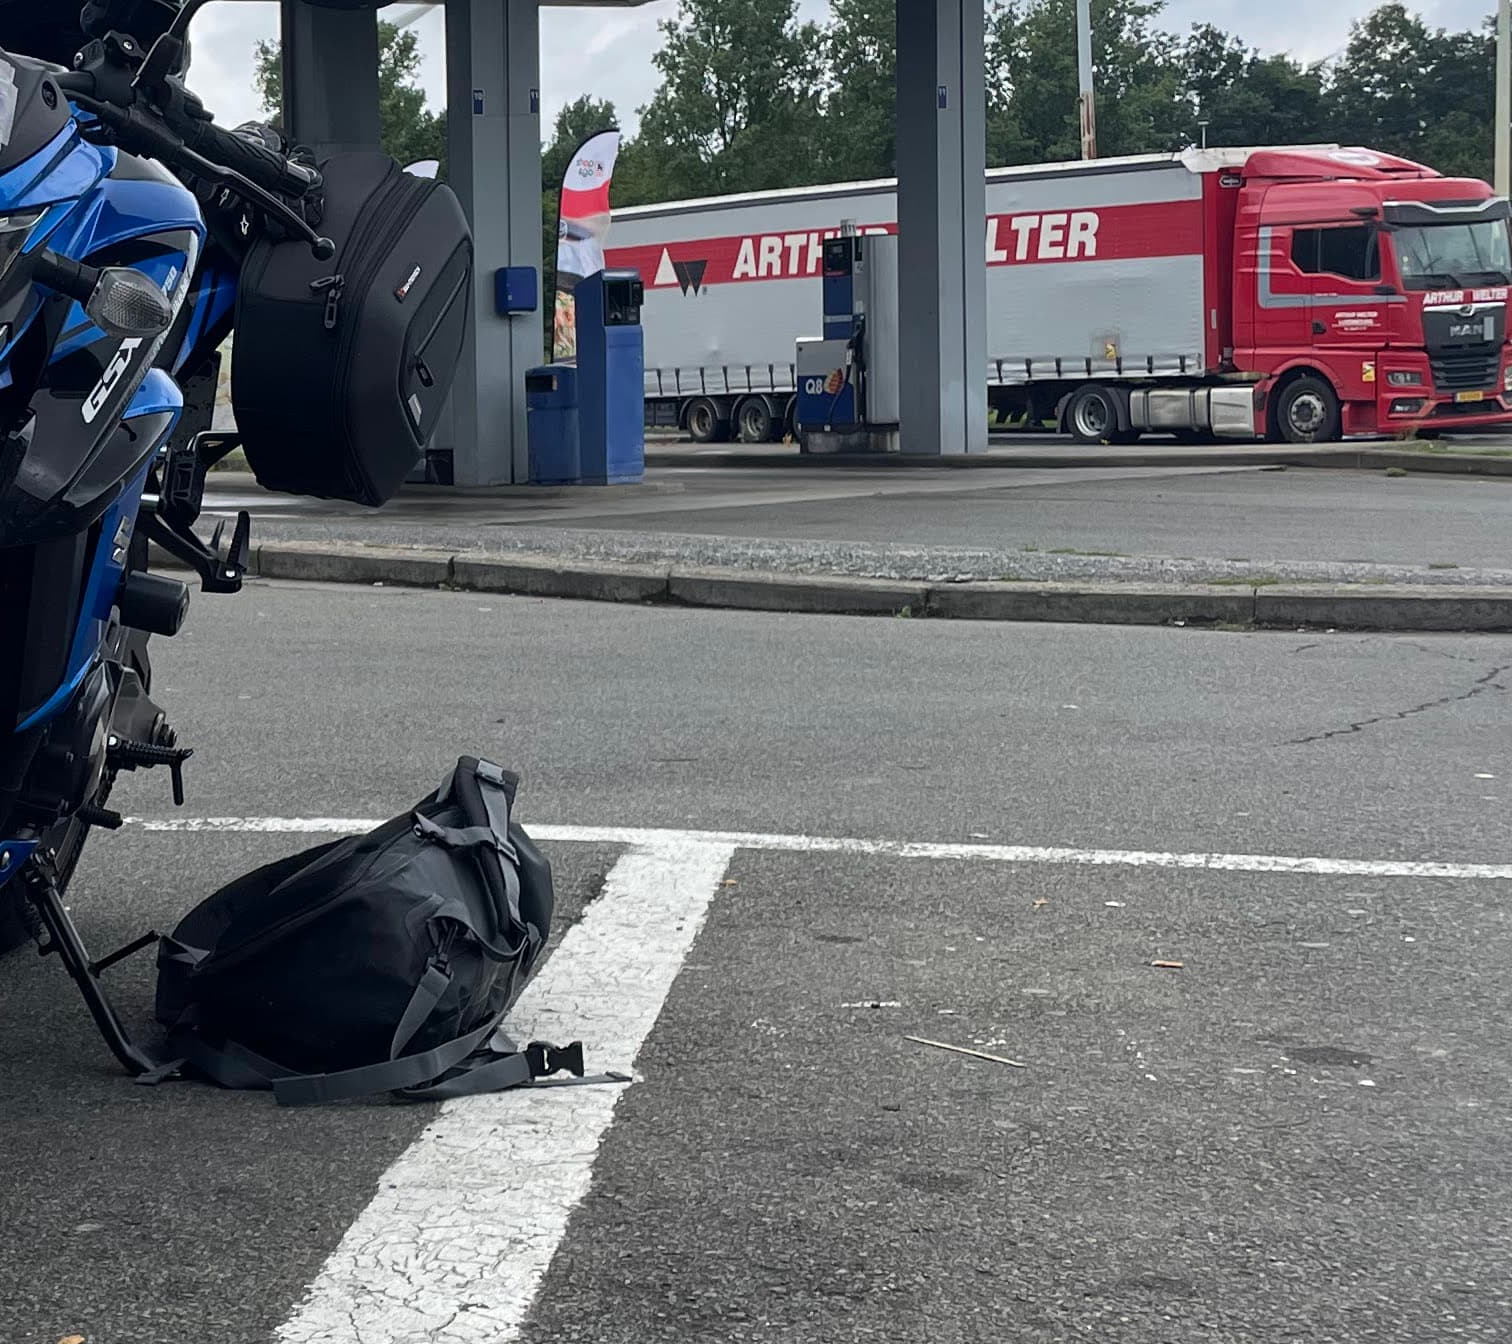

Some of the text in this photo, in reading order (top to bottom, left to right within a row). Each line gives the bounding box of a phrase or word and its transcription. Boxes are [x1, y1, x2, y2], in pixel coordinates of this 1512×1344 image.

[985, 212, 1099, 262] LTER
[1423, 288, 1508, 305] ARTHUR WELTER
[1449, 324, 1484, 337] MAN
[805, 378, 823, 395] Q8
